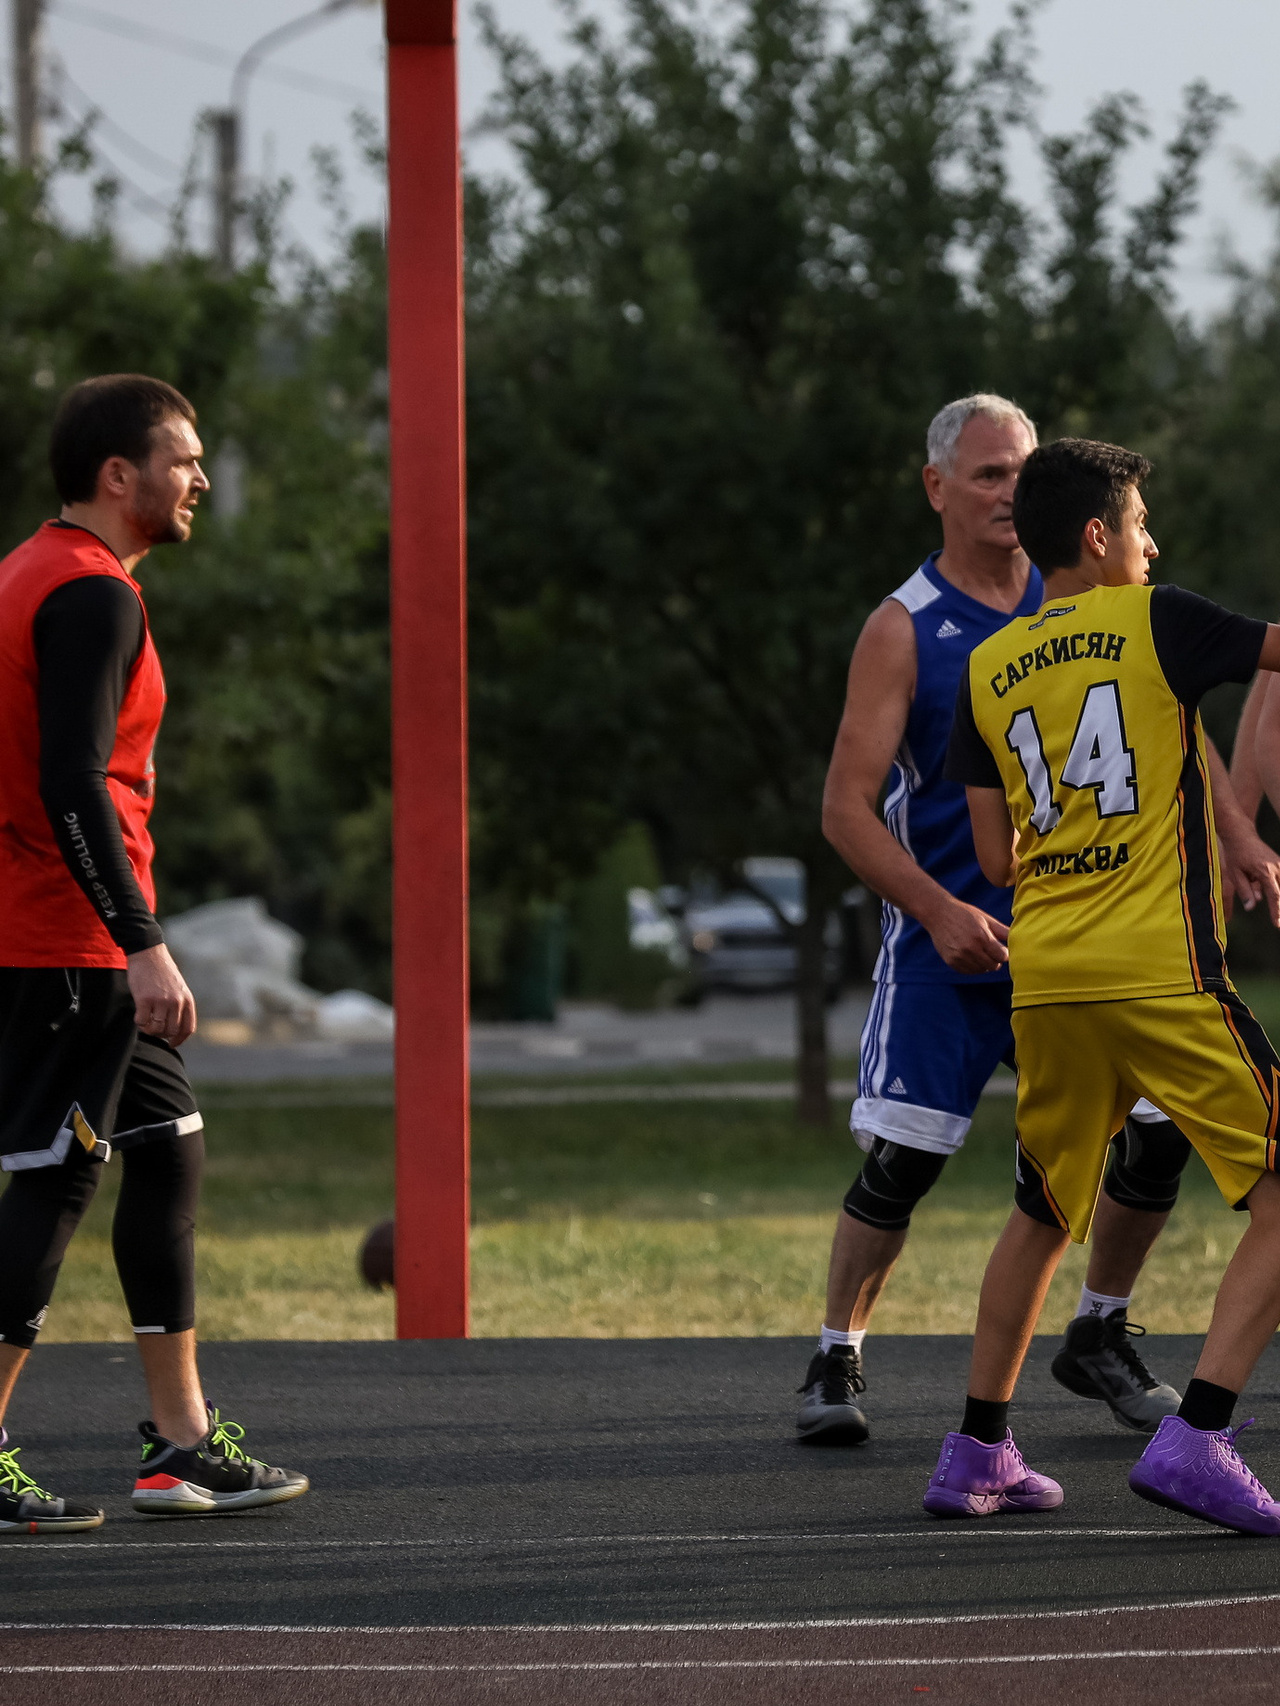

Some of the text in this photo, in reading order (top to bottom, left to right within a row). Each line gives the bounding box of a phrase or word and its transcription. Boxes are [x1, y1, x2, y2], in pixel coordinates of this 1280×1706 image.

[989, 631, 1126, 698] САРКИСЯН
[1004, 678, 1139, 837] 14
[64, 812, 117, 919] KEEP ROLLING
